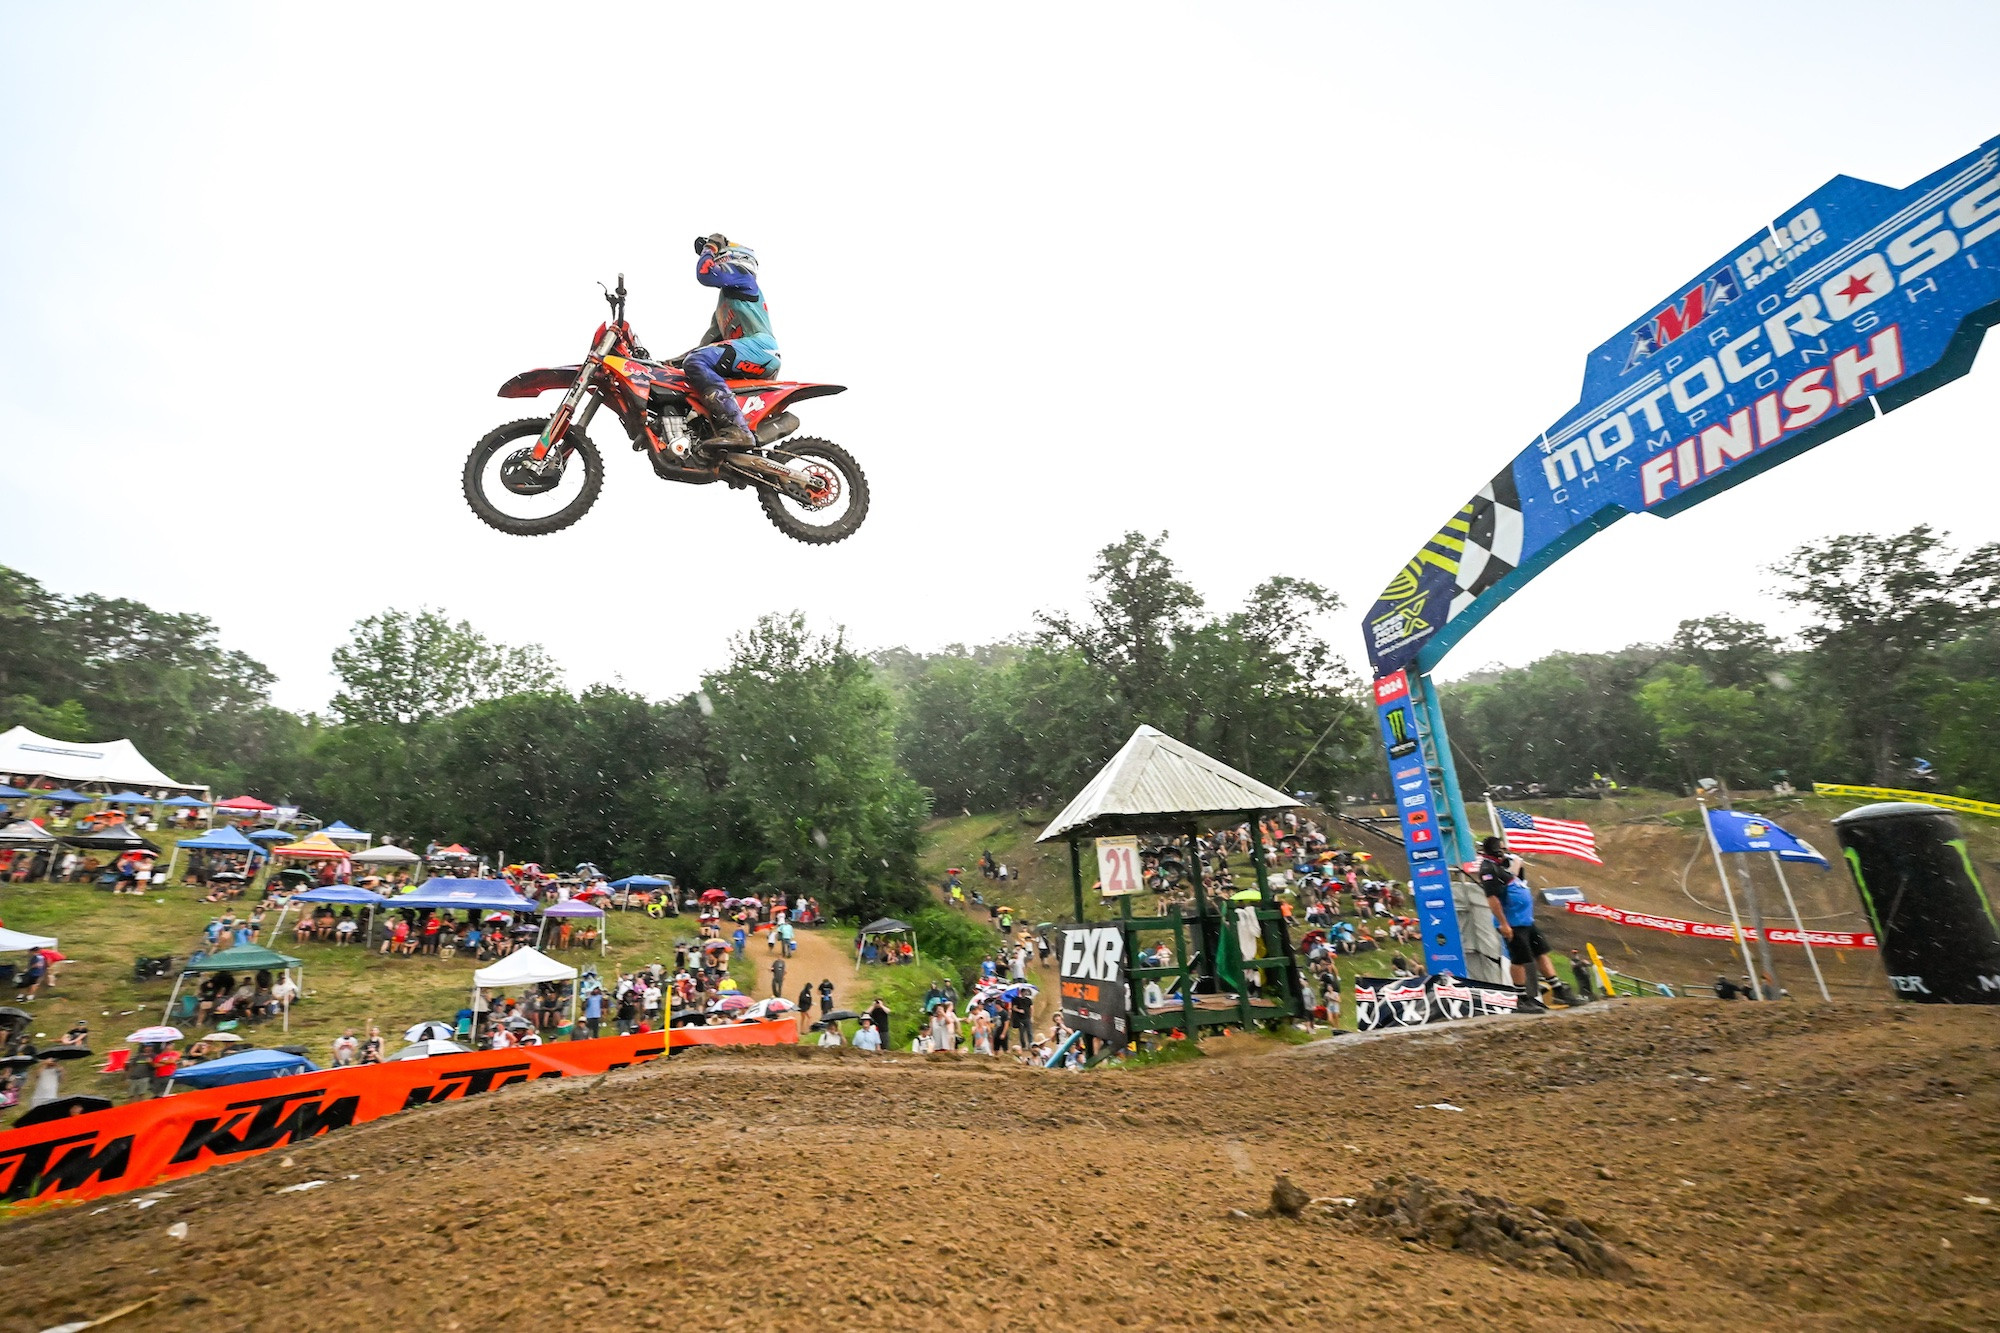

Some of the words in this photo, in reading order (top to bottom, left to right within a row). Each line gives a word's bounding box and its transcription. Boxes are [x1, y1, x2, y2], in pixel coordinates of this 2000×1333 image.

[1736, 207, 1821, 280] PRO
[1744, 230, 1828, 291] RACING
[1541, 172, 2000, 490] MOTOCROSS
[1618, 265, 1743, 377] AMA
[736, 359, 767, 376] KTM
[741, 395, 766, 416] 4
[1639, 322, 1905, 507] FINISH
[1377, 677, 1404, 698] 2024
[1105, 848, 1137, 891] 21
[1624, 914, 1687, 933] GASGAS
[1061, 926, 1125, 983] FXR
[169, 1088, 361, 1165] KTM
